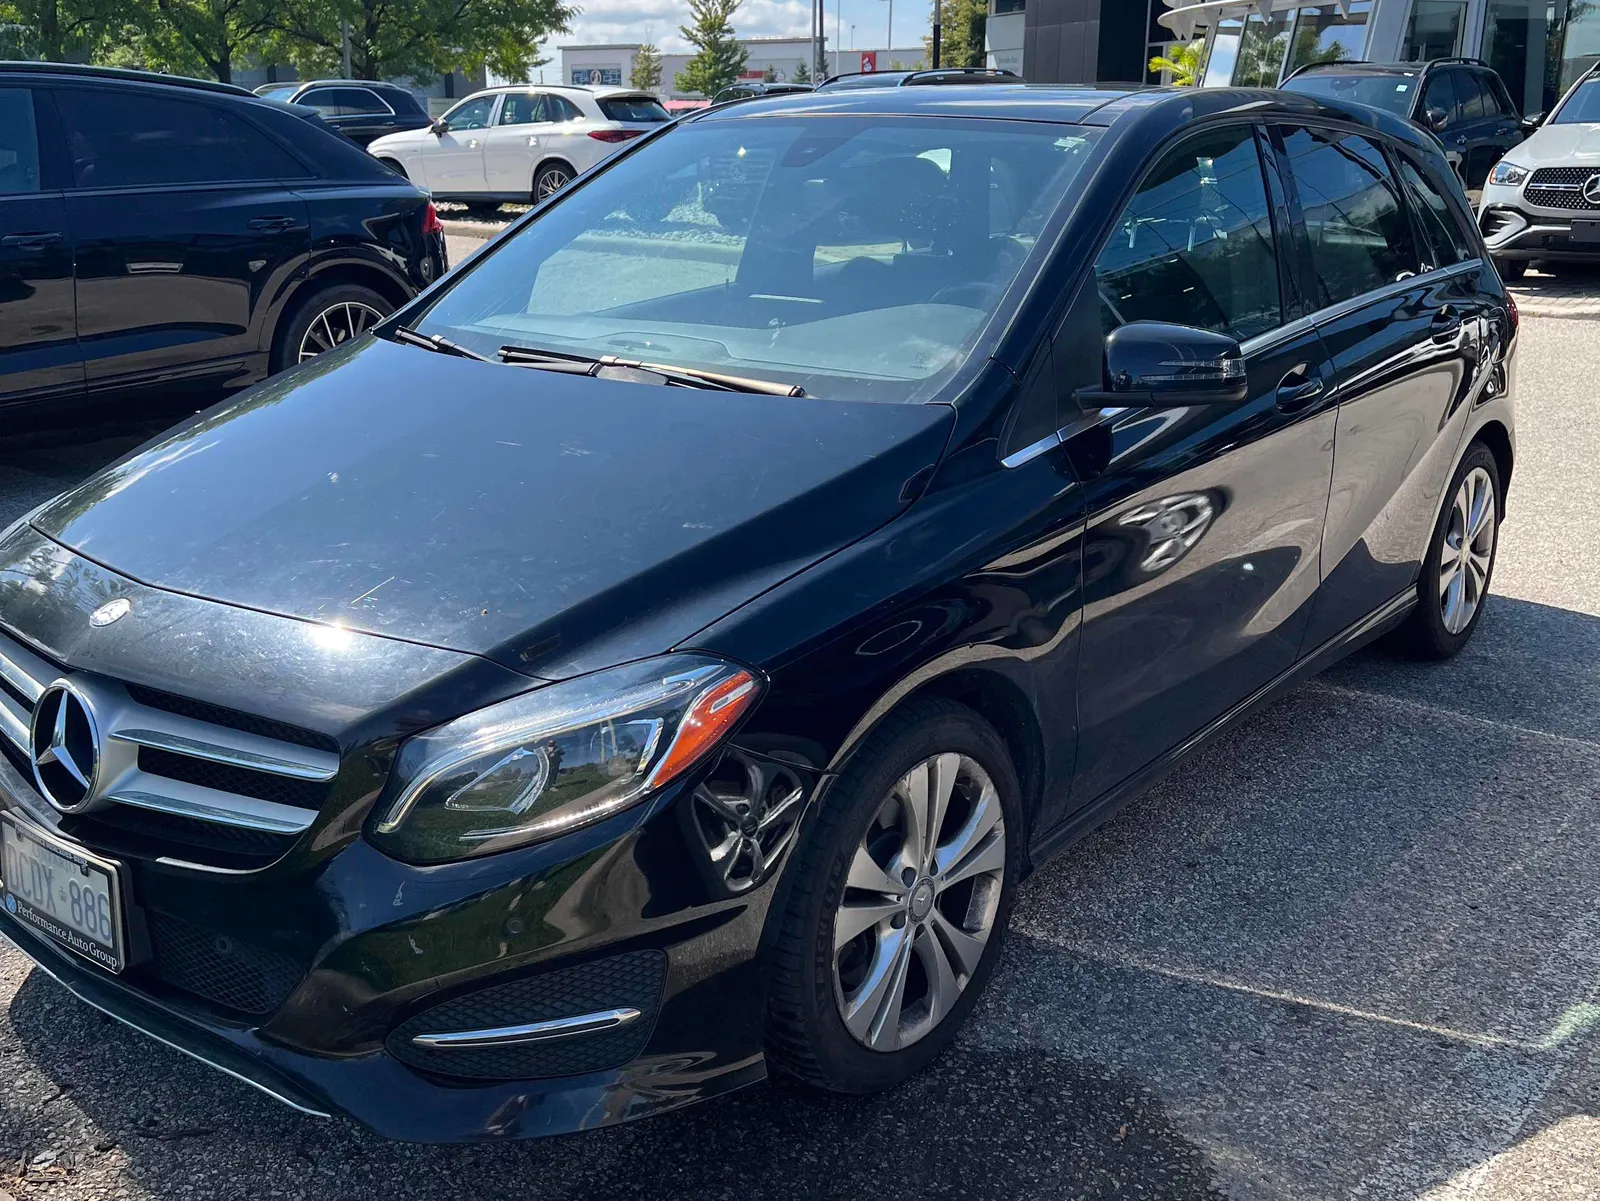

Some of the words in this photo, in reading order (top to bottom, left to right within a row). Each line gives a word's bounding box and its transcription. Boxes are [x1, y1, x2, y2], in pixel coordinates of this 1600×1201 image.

[17, 901, 67, 939] Performance
[67, 930, 88, 951] Auto
[89, 941, 117, 970] Group
[69, 877, 111, 941] 886
